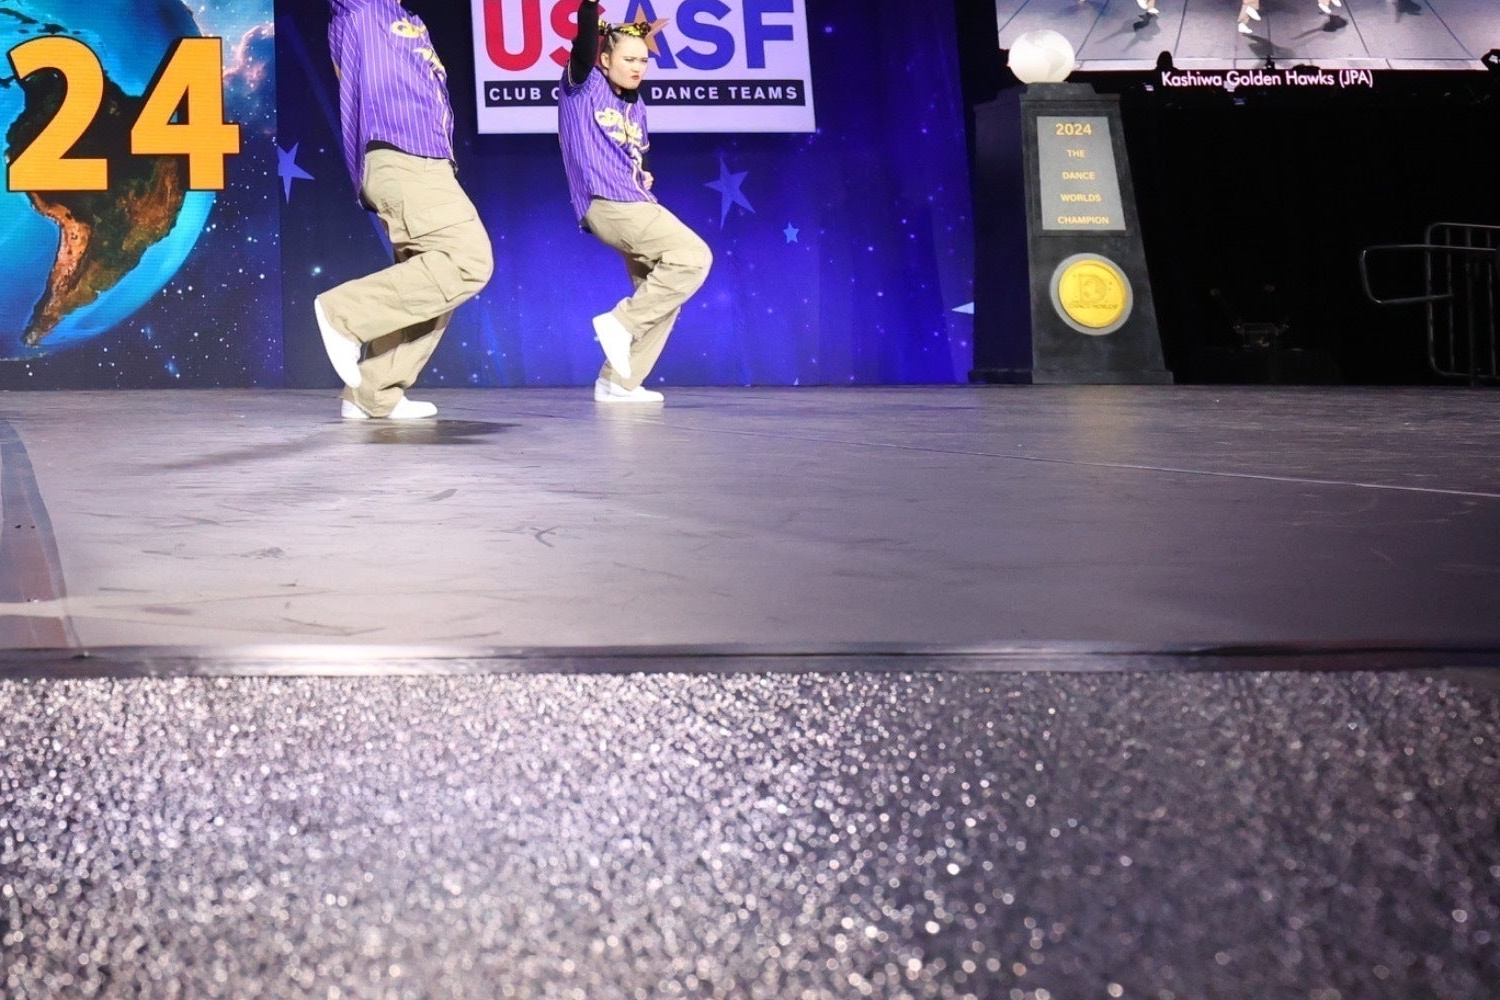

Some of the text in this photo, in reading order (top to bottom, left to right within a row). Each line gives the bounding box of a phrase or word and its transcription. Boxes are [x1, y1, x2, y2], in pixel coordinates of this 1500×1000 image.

[1161, 69, 1373, 88] Kashiwa Golden Hawks (JPA)
[489, 87, 542, 101] CLUB
[652, 86, 719, 100] DANCE
[728, 86, 797, 100] TEAMS
[1056, 123, 1092, 136] 2024
[1067, 149, 1085, 157] THE
[1062, 171, 1095, 180] DANCE
[1061, 193, 1101, 202] WORLDS
[1057, 216, 1109, 225] CHAMPION
